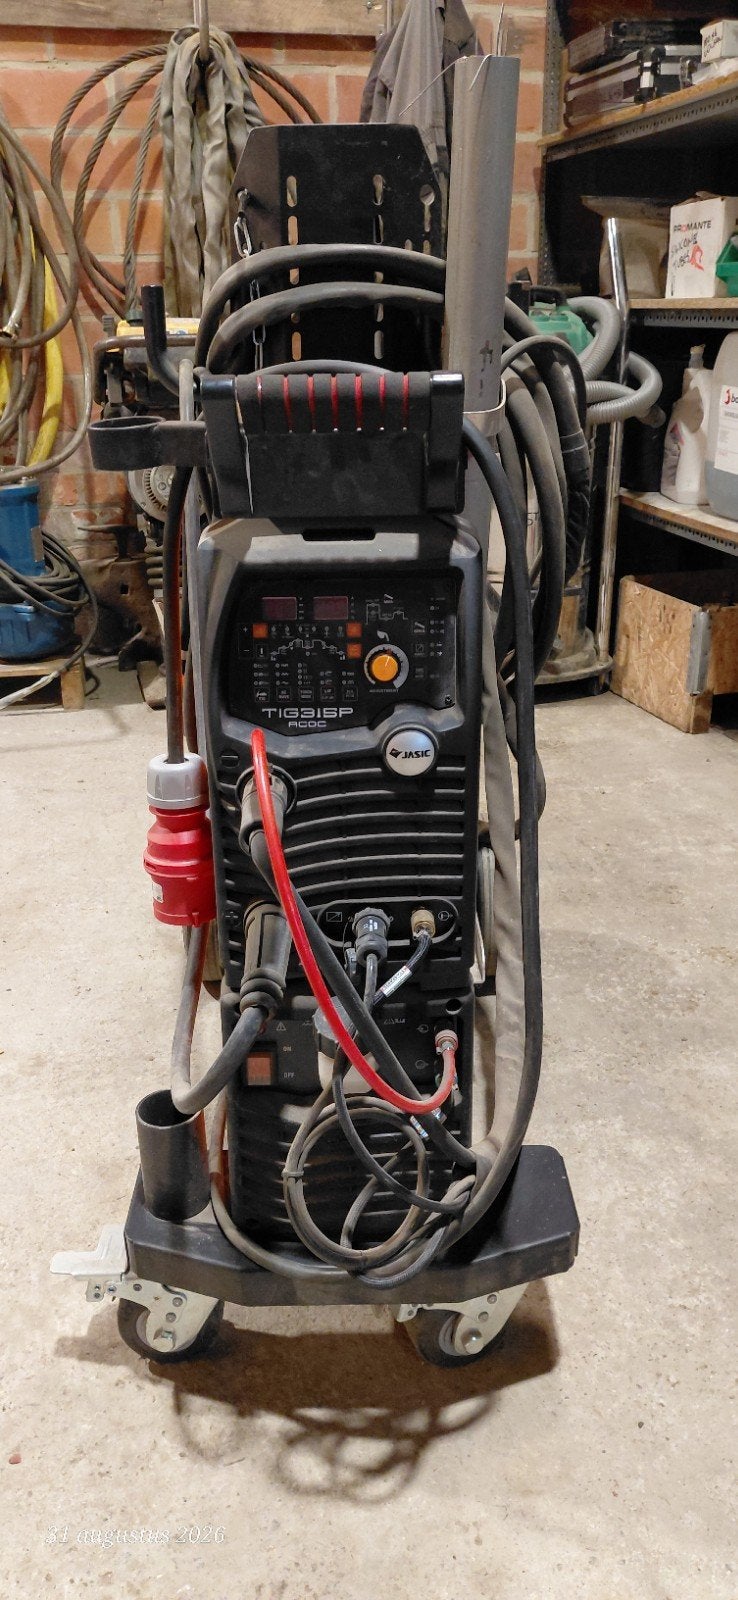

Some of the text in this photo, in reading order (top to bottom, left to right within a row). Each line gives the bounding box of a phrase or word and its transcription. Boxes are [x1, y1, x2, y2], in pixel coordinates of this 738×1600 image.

[673, 220, 711, 231] PROMANTE
[262, 707, 354, 718] TIG315P
[401, 750, 431, 758] JASIC
